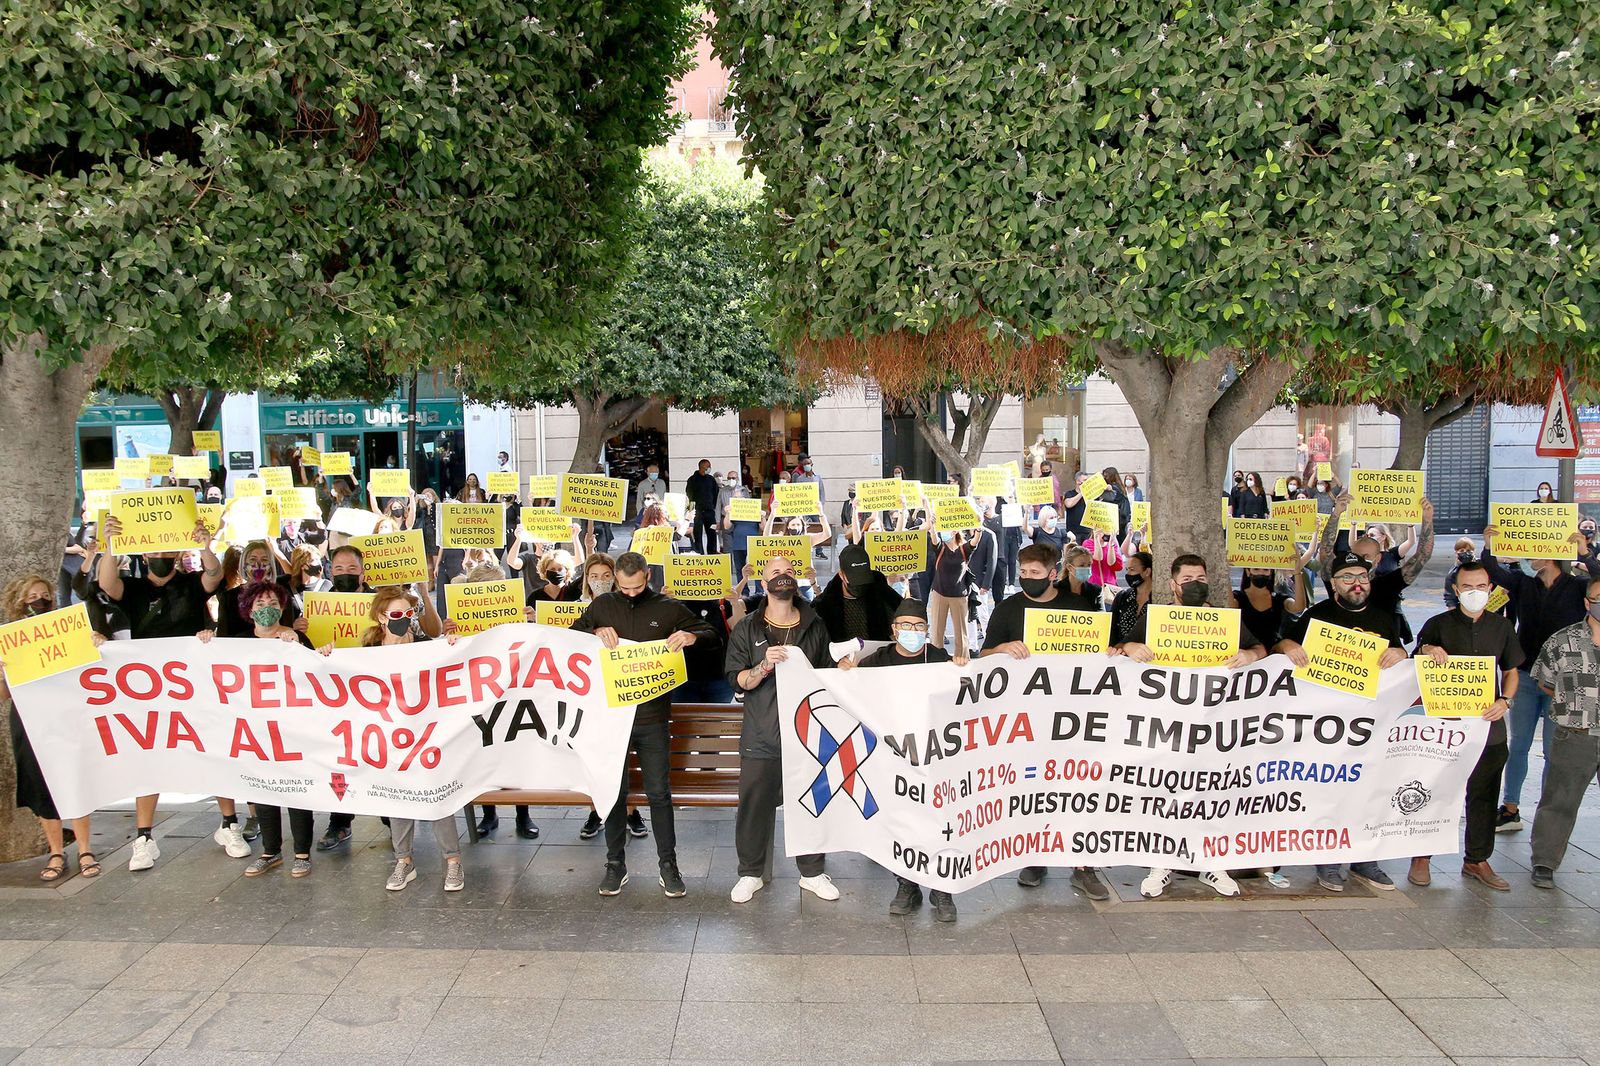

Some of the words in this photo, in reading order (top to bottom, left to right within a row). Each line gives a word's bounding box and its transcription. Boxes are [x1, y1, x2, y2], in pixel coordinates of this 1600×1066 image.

[285, 409, 356, 426] Edificio
[568, 476, 606, 488] CORTARSE
[611, 480, 620, 489] EL
[1357, 473, 1404, 482] CORTARSE
[1407, 474, 1417, 482] EL
[568, 486, 589, 495] PELO
[591, 488, 600, 496] ES
[602, 489, 618, 498] UNA
[1359, 485, 1381, 494] PELO
[1383, 485, 1394, 494] ES
[1396, 486, 1416, 494] UNA
[121, 497, 144, 509] POR
[147, 496, 163, 507] UN
[166, 494, 184, 506] IVA
[571, 496, 614, 508] NECESIDAD
[863, 495, 896, 503] NUESTROS
[1361, 496, 1411, 505] NECESIDAD
[136, 510, 172, 523] JUSTO
[463, 507, 479, 515] 21%
[592, 508, 606, 516] 10%
[607, 510, 620, 518] YA!
[1272, 506, 1287, 518] ¡IVA
[1351, 509, 1368, 517] ¡IVA
[1384, 509, 1401, 517] 10%
[1498, 507, 1554, 516] CORTARSE
[1557, 508, 1570, 516] EL
[457, 517, 488, 525] CIERRA
[1234, 522, 1277, 531] CORTARSE
[1280, 523, 1290, 531] EL
[1500, 518, 1526, 528] PELO
[1530, 519, 1543, 528] ES
[1546, 520, 1568, 528] UNA
[450, 527, 495, 535] NUESTROS
[1235, 532, 1257, 540] PELO
[1259, 533, 1269, 541] ES
[1272, 534, 1289, 542] UNA
[1504, 531, 1563, 541] NECESIDAD
[115, 536, 137, 549] ¡IVA
[140, 534, 154, 545] AL
[158, 532, 179, 543] 10%
[364, 536, 384, 548] QUE
[386, 535, 406, 545] NOS
[451, 537, 495, 545] NEGOCIOS
[874, 535, 885, 543] EL
[887, 535, 903, 543] 21%
[905, 533, 919, 541] IVA
[881, 545, 912, 553] CIERRA
[1239, 543, 1285, 552] NECESIDAD
[1495, 543, 1513, 552] ¡IVA
[1516, 544, 1529, 552] AL
[1532, 544, 1552, 553] 10%
[1555, 545, 1572, 553] YA!
[371, 557, 418, 570] NUESTRO
[686, 558, 703, 566] 21%
[874, 553, 919, 563] NUESTROS
[680, 569, 714, 577] CIERRA
[875, 563, 918, 572] NEGOCIOS
[390, 570, 407, 580] 10%
[410, 569, 425, 578] YA!
[673, 578, 722, 587] NUESTROS
[463, 586, 482, 596] QUE
[486, 584, 507, 594] NOS
[674, 588, 722, 597] NEGOCIOS
[457, 595, 515, 608] DEVUELVAN
[306, 600, 331, 620] ¡IVA
[457, 611, 469, 620] LO
[472, 608, 518, 619] NUESTRO
[1169, 610, 1192, 621] QUE
[1195, 611, 1218, 622] NOS
[1046, 614, 1068, 625] QUE
[1070, 614, 1093, 625] NOS
[333, 623, 358, 642] ¡YA!
[1037, 627, 1099, 639] DEVUELVAN
[1160, 623, 1226, 636] DEVUELVAN
[0, 629, 31, 656] ¡IVA
[1157, 638, 1171, 648] LO
[1175, 639, 1228, 650] NUESTRO
[1320, 627, 1333, 639] EL
[1336, 631, 1357, 646] 21%
[1359, 638, 1377, 651] IVA
[610, 650, 624, 661] EL
[627, 647, 648, 659] 21%
[651, 645, 669, 656] IVA
[1034, 642, 1048, 652] LO
[1050, 642, 1099, 654] NUESTRO
[1324, 643, 1363, 662] CIERRA
[39, 642, 68, 668] ¡YA!
[621, 660, 663, 674] CIERRA
[1311, 654, 1369, 678] NUESTROS
[1478, 661, 1489, 670] EL
[80, 661, 194, 705] SOS
[212, 641, 592, 722] PELUQUERÍAS
[614, 668, 676, 689] NUESTROS
[1307, 668, 1366, 692] NEGOCIOS
[1425, 673, 1448, 683] PELO
[1451, 674, 1464, 683] ES
[1467, 674, 1488, 684] UNA
[618, 679, 676, 702] NEGOCIOS
[955, 666, 1009, 705] NO
[1023, 667, 1053, 695] A
[1069, 666, 1121, 696] LA
[1138, 668, 1298, 707] SUBIDA
[1430, 687, 1483, 697] NECESIDAD
[95, 711, 205, 756] IVA
[230, 717, 303, 761] AL
[331, 719, 442, 771] 10%
[884, 711, 1035, 767] MASIVA
[1051, 711, 1109, 743] DE
[1123, 712, 1376, 754] IMPUESTOS
[1388, 721, 1466, 750] aneip
[895, 774, 925, 804] Del
[933, 778, 957, 809] 8%
[960, 770, 972, 798] al
[977, 762, 1016, 792] 21%
[1025, 766, 1037, 779] =
[1044, 759, 1103, 781] 8.000
[1110, 763, 1251, 793] PELUQUERÍAS
[1256, 760, 1361, 785] CERRADAS
[957, 798, 1002, 838] 20.000
[1009, 792, 1098, 818] PUESTOS
[1105, 792, 1134, 813] DE
[1140, 795, 1230, 820] TRABAJO
[1234, 791, 1305, 816] MENOS.
[893, 840, 930, 875] POR
[937, 853, 973, 880] UNA
[975, 823, 1064, 871] ECONOMÍA
[1071, 830, 1195, 863] SOSTENIDA,
[1202, 835, 1228, 857] NO
[1234, 827, 1350, 855] SUMERGIDA
